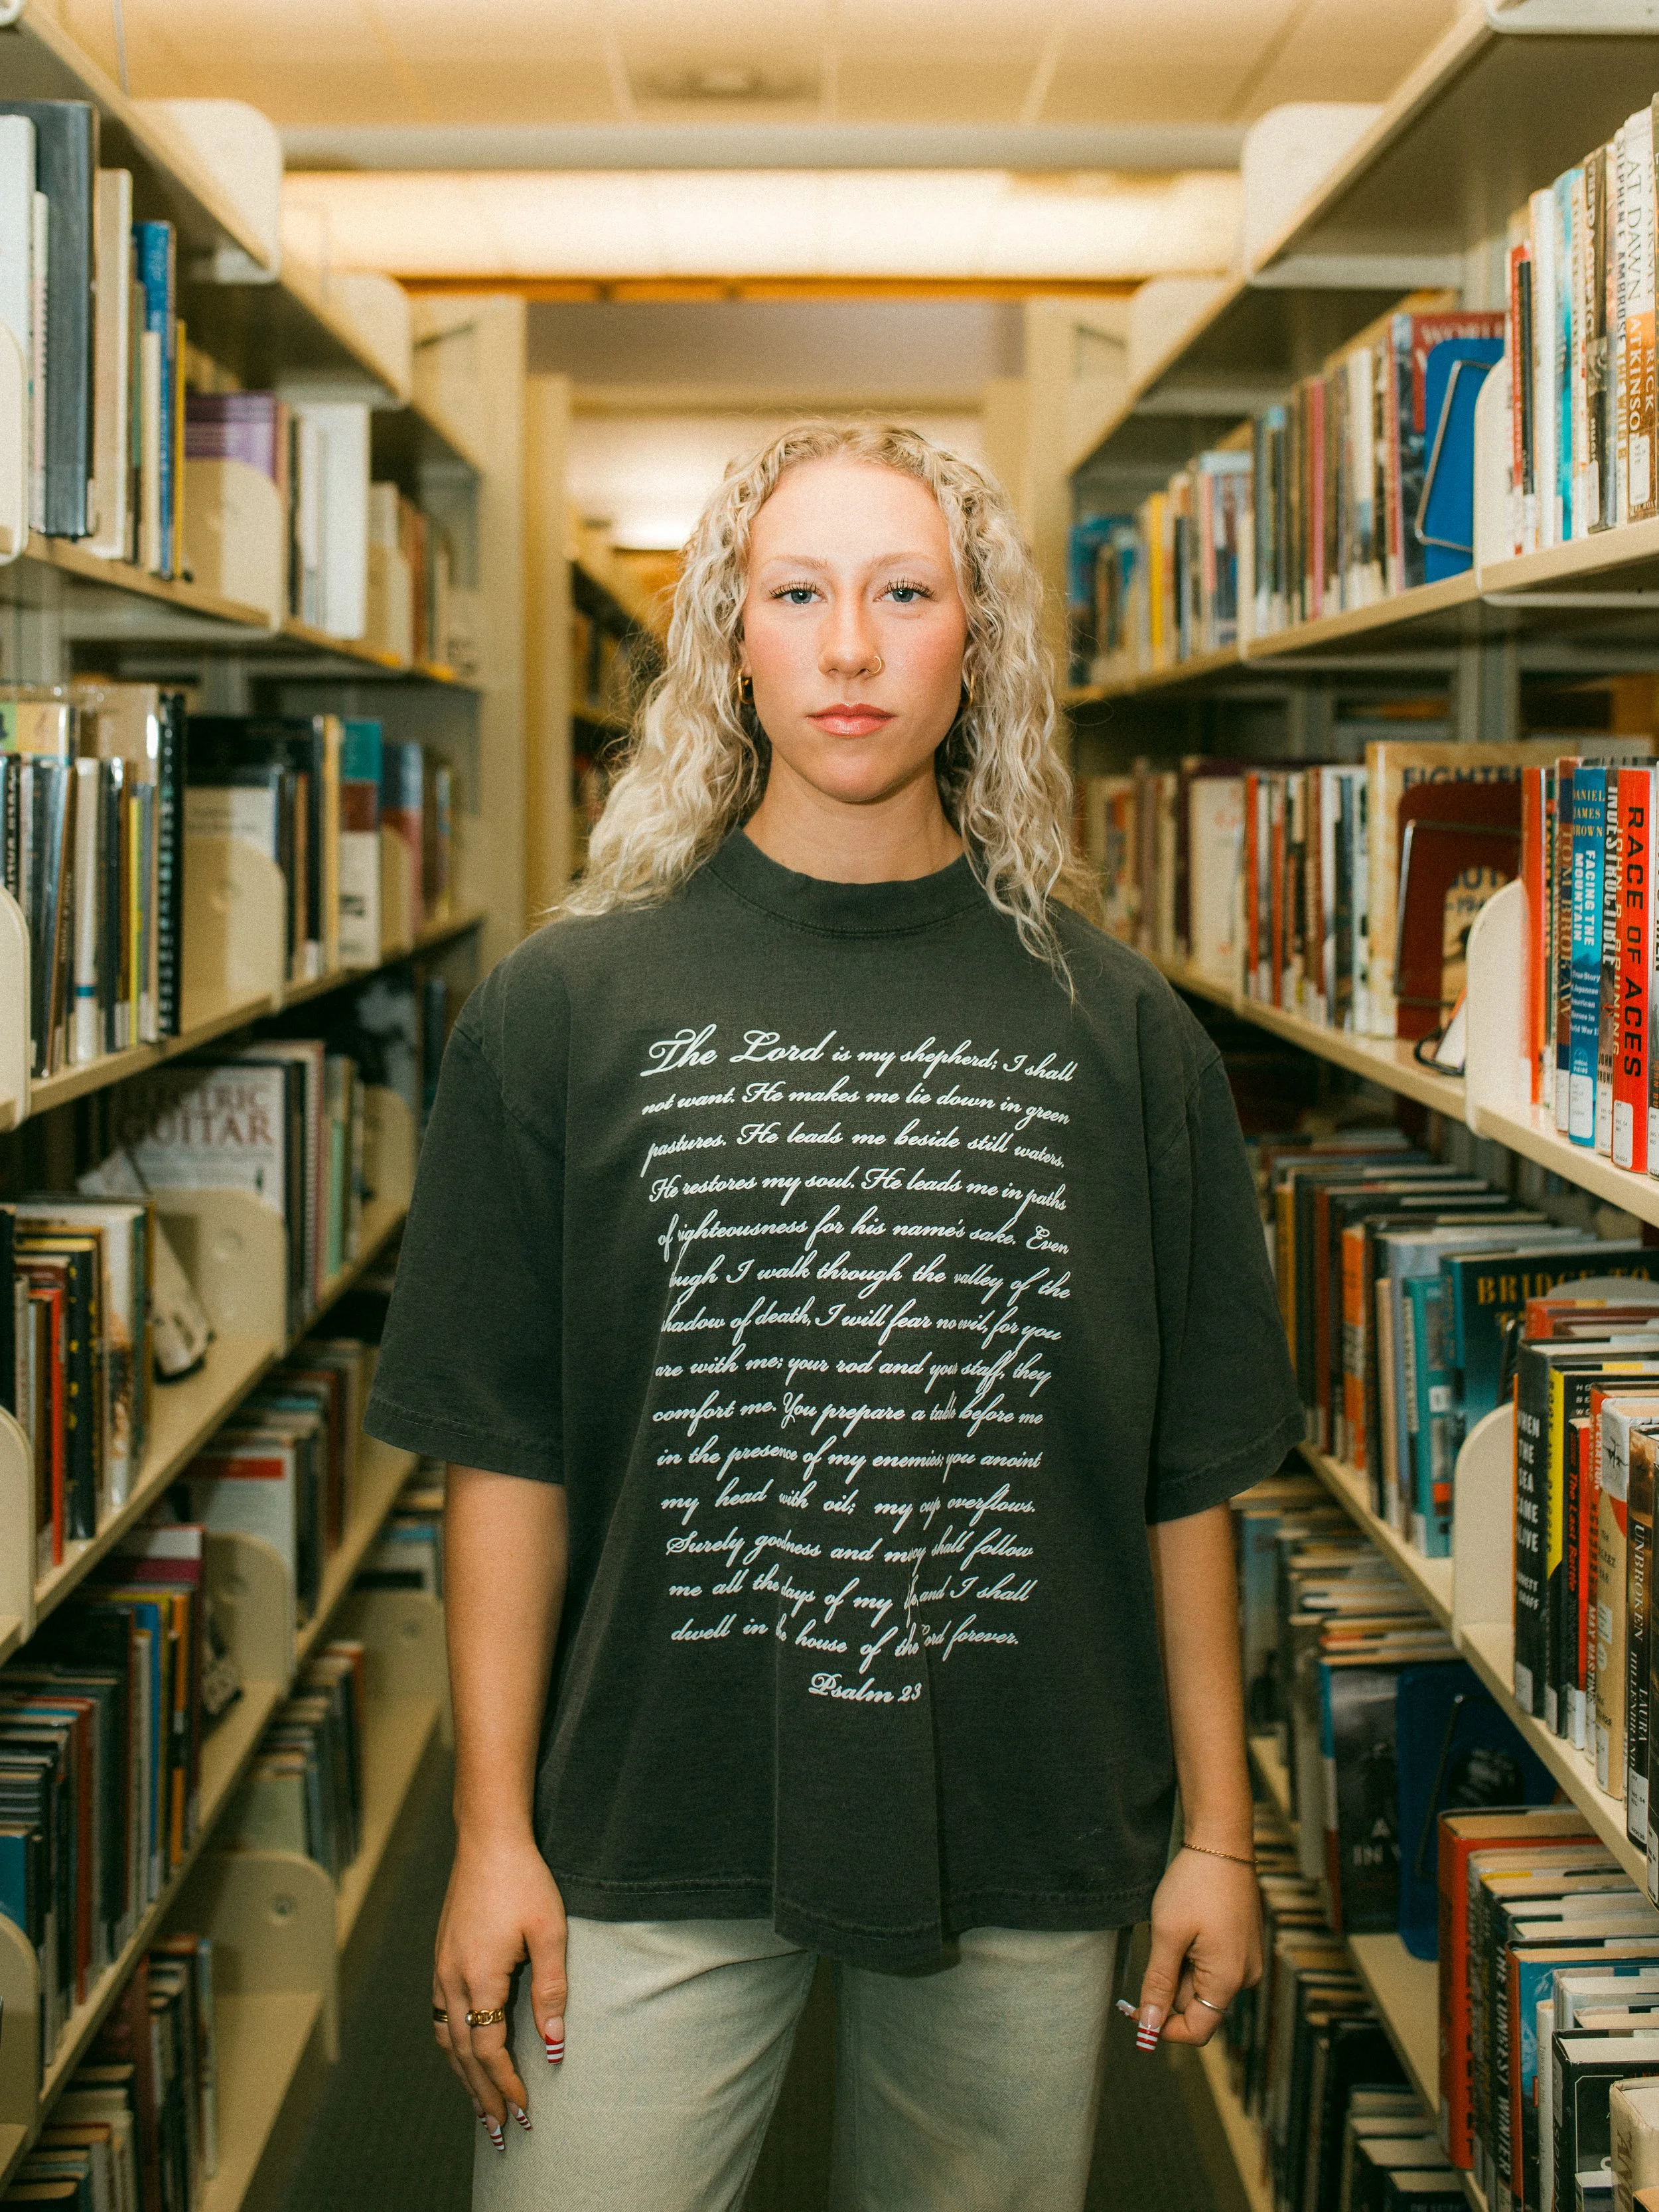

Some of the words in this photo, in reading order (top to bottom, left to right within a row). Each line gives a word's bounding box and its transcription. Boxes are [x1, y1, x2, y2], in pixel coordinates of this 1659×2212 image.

[1628, 161, 1641, 194] AT
[1627, 207, 1642, 301] DAWN
[1628, 317, 1642, 439] ATKINSO
[1645, 348, 1654, 410] RICK
[1561, 831, 1573, 886] TOM
[1585, 849, 1596, 910] FACING
[1603, 786, 1618, 966] INDESTRUCTIBLE
[1627, 806, 1644, 910] RACE
[1573, 852, 1584, 942] MOUNTAIN
[1584, 913, 1595, 946] THE
[1627, 925, 1642, 965] OF
[640, 1023, 717, 1077] The
[729, 1029, 837, 1063] Lord
[831, 1046, 853, 1061] is
[857, 1048, 896, 1077] my
[901, 1036, 999, 1078] shepherd;
[1002, 1054, 1027, 1071] I
[1025, 1053, 1078, 1083] shall
[1623, 976, 1642, 1077] ACES
[641, 1095, 675, 1115] not
[677, 1087, 735, 1109] want.
[741, 1081, 784, 1103] He
[788, 1075, 861, 1104] makes
[865, 1091, 901, 1104] me
[905, 1082, 933, 1105] lie
[936, 1083, 995, 1109] down
[999, 1096, 1024, 1113] in
[1015, 1103, 1070, 1131] green
[640, 1133, 727, 1178] pastures.
[736, 1122, 780, 1145] He
[786, 1122, 844, 1145] leads
[851, 1132, 887, 1146] me
[893, 1117, 962, 1149] beside
[966, 1131, 1009, 1154] still
[1013, 1143, 1066, 1169] waters.
[648, 1177, 679, 1203] He
[681, 1173, 756, 1194] restores
[761, 1174, 803, 1207] my
[804, 1165, 855, 1189] soul.
[861, 1167, 902, 1192] He
[906, 1167, 963, 1194] leads
[966, 1181, 999, 1196] me
[1000, 1180, 1024, 1200] in
[1013, 1183, 1067, 1221] paths
[657, 1213, 680, 1263] of
[676, 1208, 809, 1262] righteousness
[804, 1204, 845, 1252] for
[850, 1205, 887, 1235] his
[892, 1218, 966, 1239] name's
[968, 1216, 1017, 1246] sake.
[1025, 1225, 1070, 1255] Even
[668, 1253, 726, 1306] ough
[725, 1259, 756, 1284] I
[757, 1249, 818, 1281] walk
[816, 1250, 903, 1300] through
[911, 1253, 947, 1284] the
[953, 1263, 1004, 1305] valley
[1007, 1267, 1050, 1308] of
[1037, 1271, 1071, 1299] the
[729, 1295, 766, 1347] of
[755, 1294, 816, 1327] death,
[814, 1302, 847, 1327] I
[841, 1303, 894, 1328] will
[877, 1298, 932, 1347] fear
[936, 1316, 958, 1330] no
[980, 1305, 1020, 1351] for
[1014, 1322, 1062, 1354] you
[654, 1363, 684, 1378] are
[689, 1342, 747, 1374] with
[745, 1355, 784, 1371] me;
[784, 1356, 830, 1387] your
[835, 1349, 883, 1375] rod
[878, 1351, 933, 1375] and
[924, 1361, 959, 1395] your
[960, 1349, 1018, 1395] staff,
[1011, 1352, 1053, 1399] they
[652, 1389, 737, 1438] comfort
[739, 1400, 777, 1416] me.
[780, 1391, 818, 1430] You
[810, 1403, 906, 1439] prepare
[910, 1407, 927, 1421] a
[929, 1389, 958, 1422] table
[958, 1392, 1015, 1438] before
[1017, 1413, 1044, 1425] me
[656, 1448, 683, 1466] in
[687, 1434, 722, 1465] the
[716, 1444, 798, 1482] presence
[802, 1434, 837, 1482] of
[827, 1453, 867, 1486] my
[942, 1452, 976, 1484] you
[979, 1451, 1044, 1468] anoint
[660, 1497, 700, 1526] my
[714, 1476, 774, 1507] head
[778, 1480, 818, 1509] with
[822, 1489, 859, 1515] oil;
[873, 1502, 914, 1535] my
[919, 1496, 942, 1531] cup
[946, 1482, 1037, 1528] overflows.
[665, 1526, 746, 1568] Surely
[741, 1529, 822, 1566] goodness
[830, 1537, 883, 1561] and
[930, 1524, 975, 1556] shall
[960, 1527, 1035, 1572] follow
[668, 1585, 703, 1597] me
[711, 1568, 750, 1596] all
[752, 1562, 780, 1592] the
[780, 1575, 816, 1618] days
[824, 1576, 861, 1624] of
[852, 1596, 893, 1629] my
[918, 1574, 952, 1603] and
[949, 1576, 979, 1599] I
[975, 1572, 1039, 1602] shall
[1634, 1523, 1645, 1642] UNBROKEN
[670, 1613, 738, 1641] dwell
[742, 1618, 769, 1635] in
[794, 1618, 848, 1653] house
[858, 1625, 899, 1675] of
[895, 1622, 920, 1657] the
[942, 1613, 1019, 1662] forever.
[808, 1672, 895, 1703] Psalm
[897, 1682, 922, 1702] 23
[1628, 1650, 1638, 1767] HILLENBRAND
[1638, 1687, 1649, 1742] LAURA
[1498, 2097, 1511, 2176] WINTER
